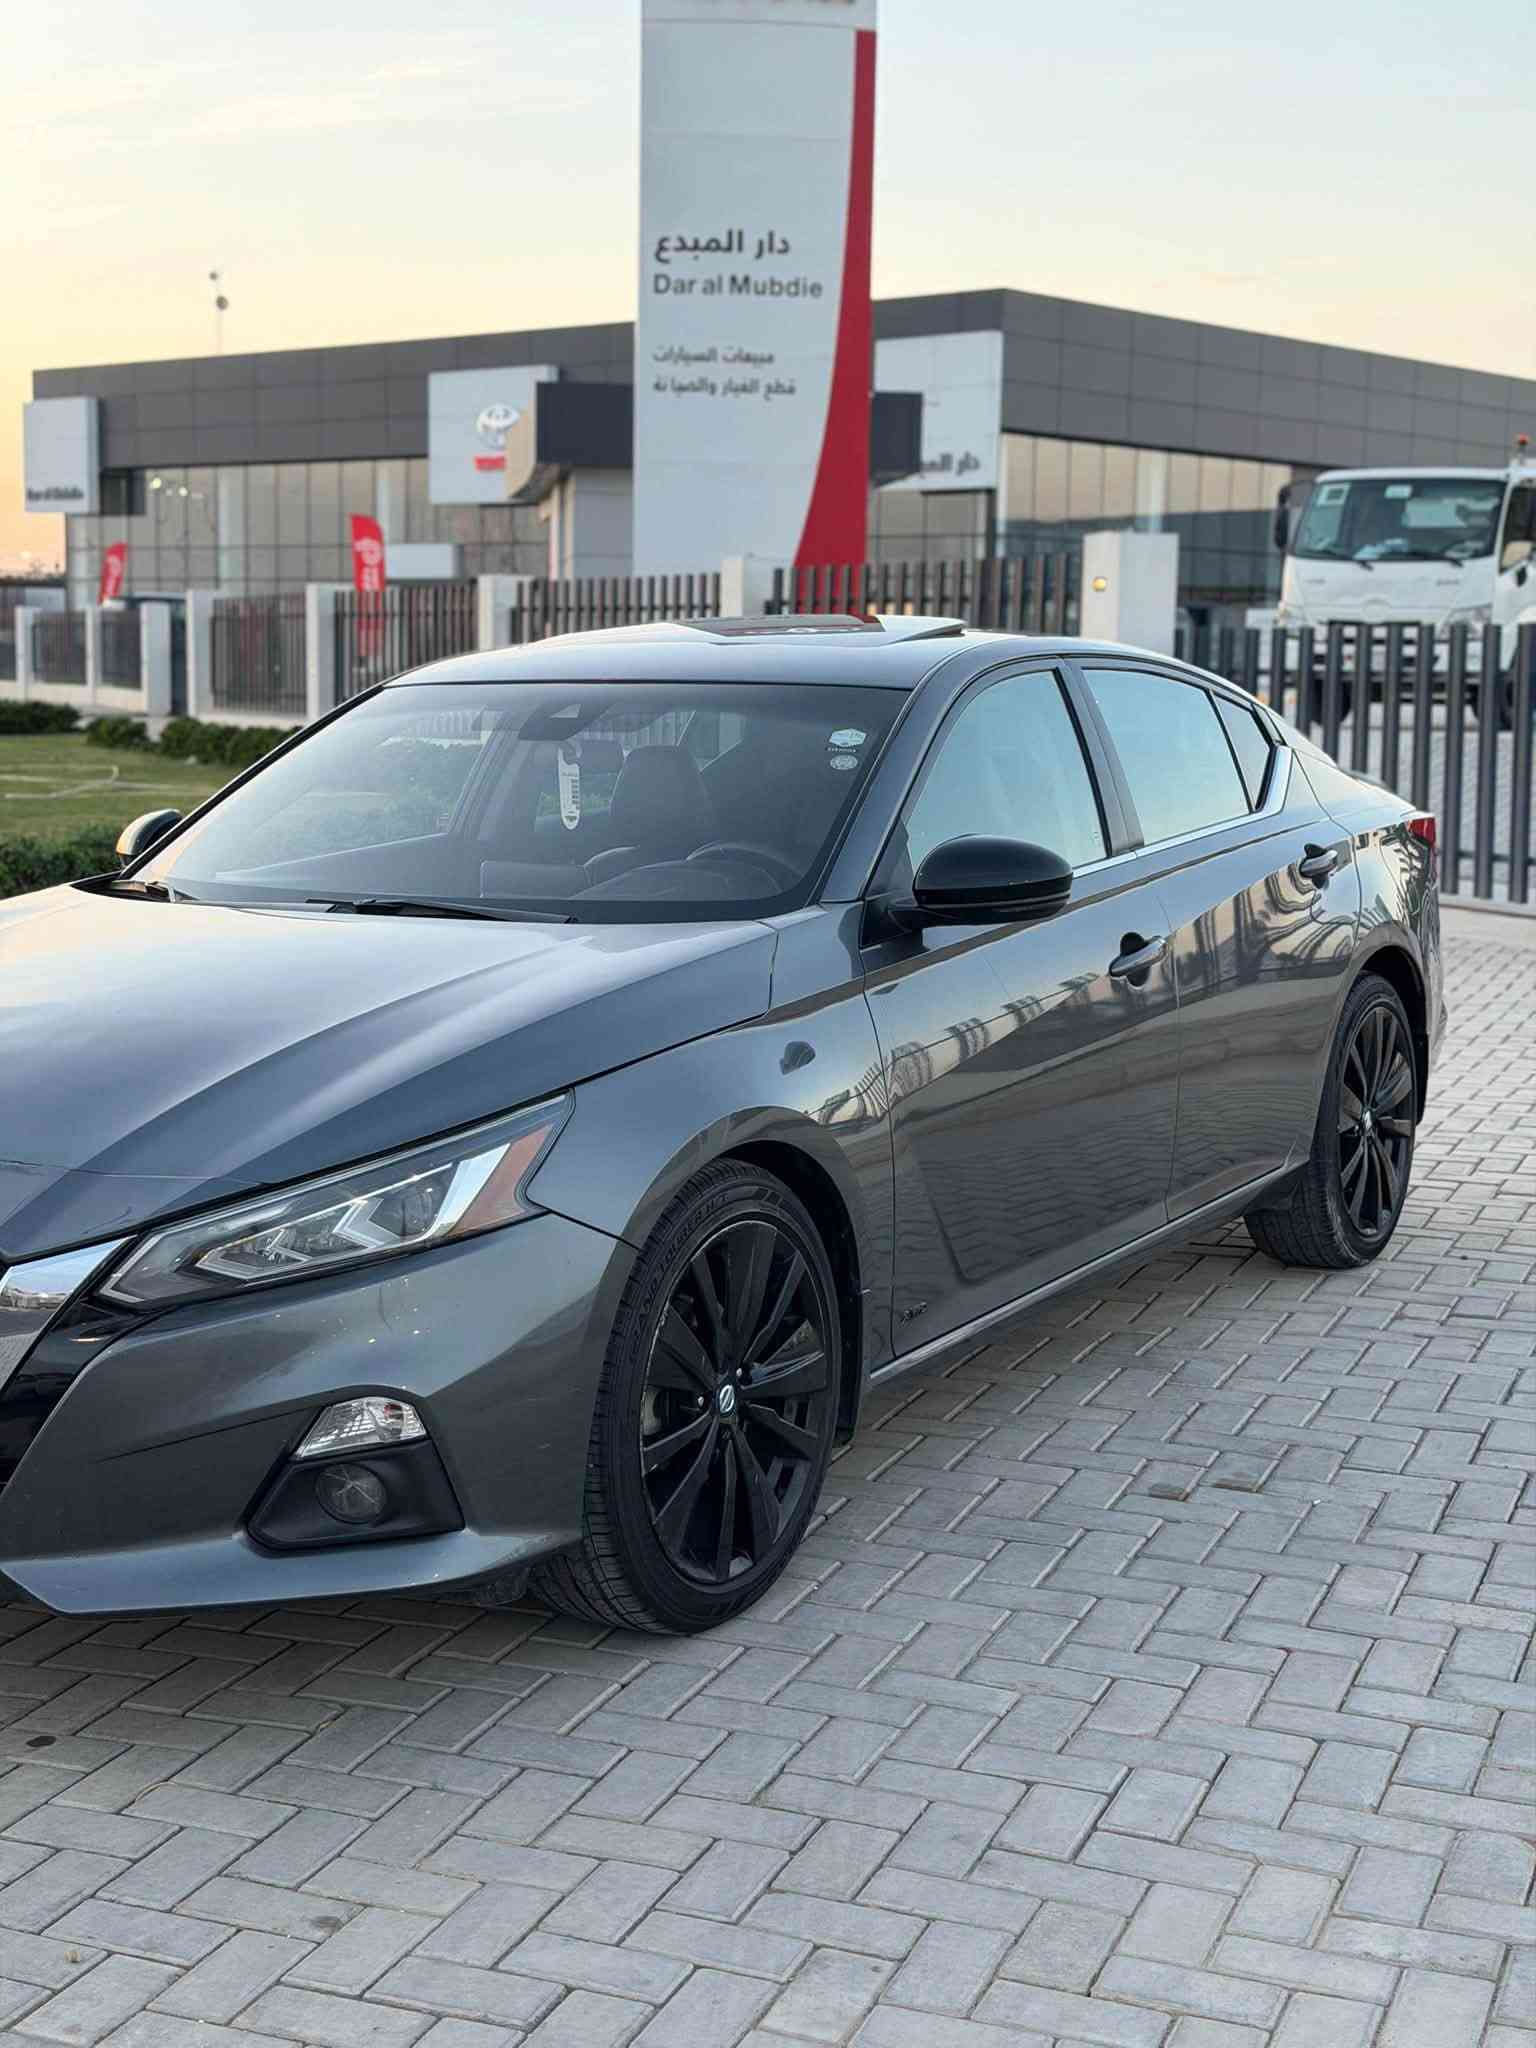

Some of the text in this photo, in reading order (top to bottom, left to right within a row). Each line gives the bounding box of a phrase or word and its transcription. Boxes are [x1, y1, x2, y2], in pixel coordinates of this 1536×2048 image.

[653, 229, 791, 264] دار المبدع
[653, 273, 823, 298] Dar al Mubdie
